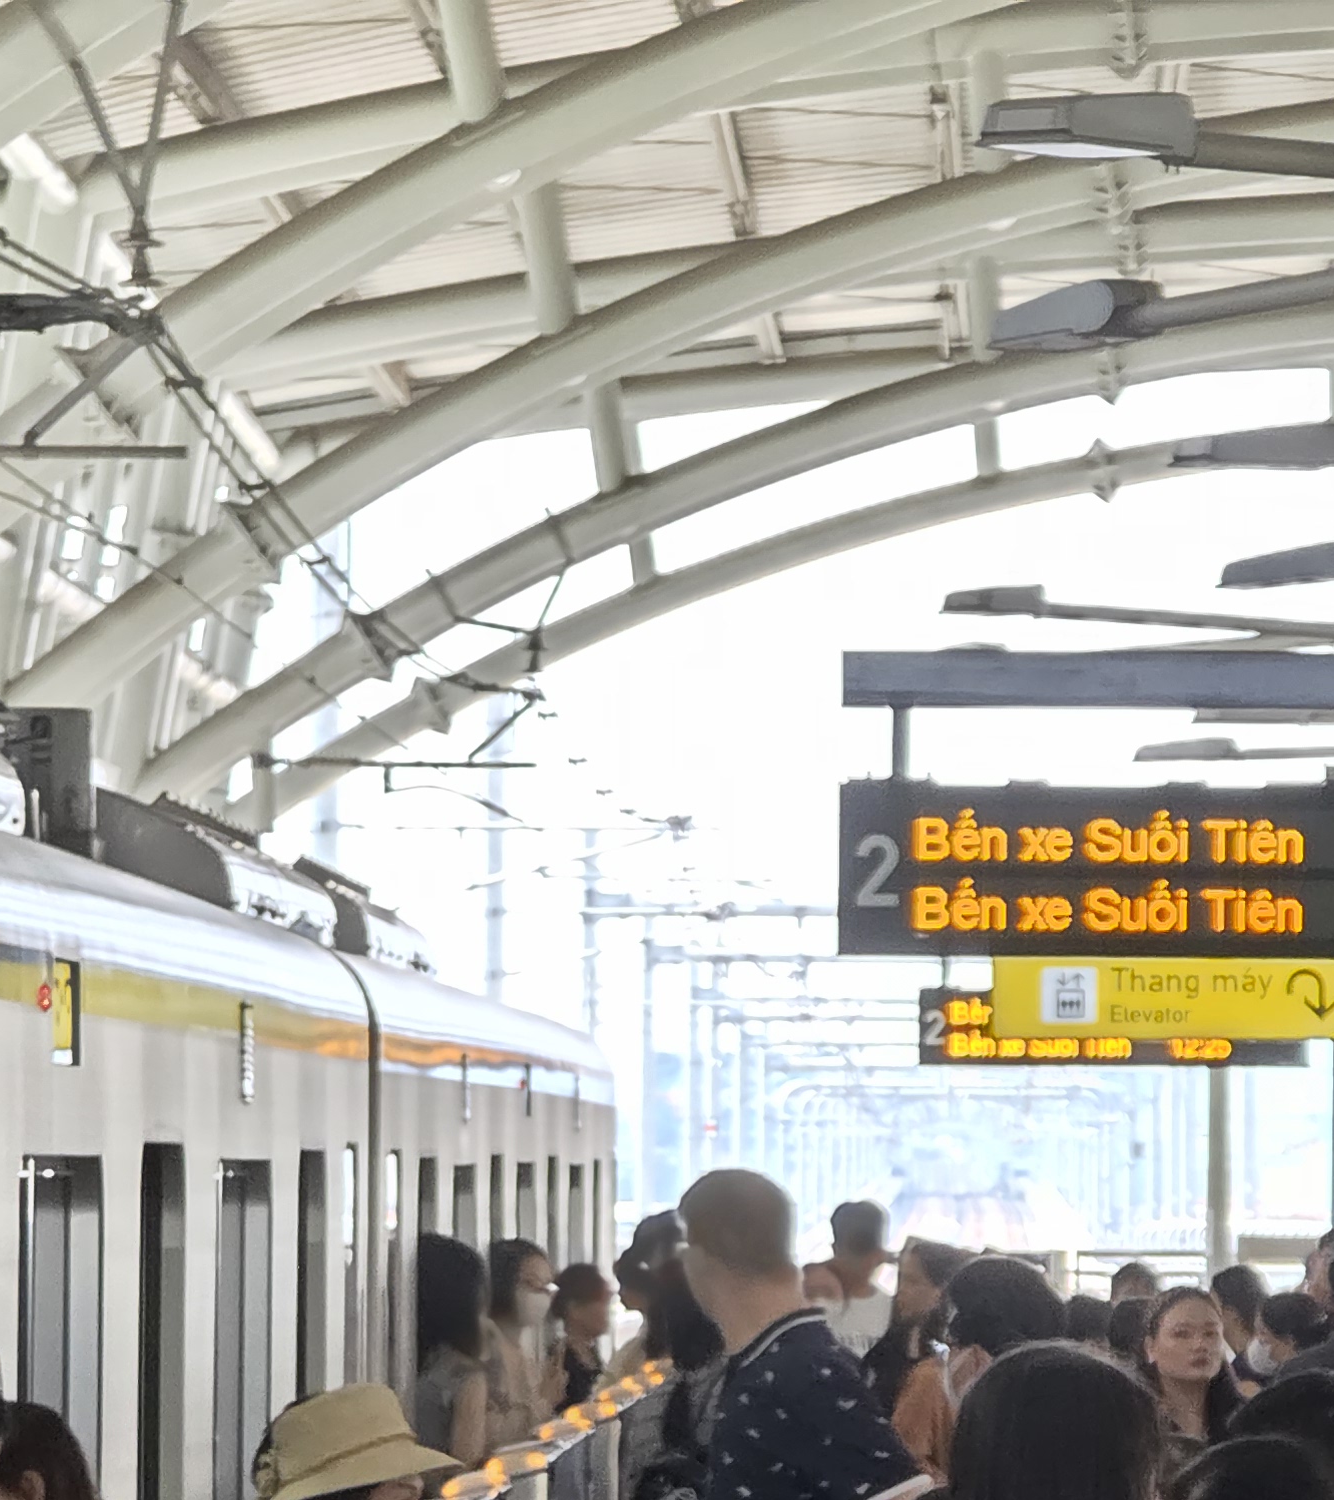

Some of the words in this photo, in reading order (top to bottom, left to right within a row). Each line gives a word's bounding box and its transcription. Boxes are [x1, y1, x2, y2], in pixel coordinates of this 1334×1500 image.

[912, 808, 1008, 863] Bến
[1017, 827, 1074, 862] xe
[1082, 809, 1188, 863] Suối
[1202, 818, 1305, 864] Tiên
[855, 833, 900, 908] 2
[912, 877, 1008, 932] Bến
[1017, 897, 1074, 932] xe
[1082, 879, 1188, 933] Suối
[1202, 888, 1305, 933] Tiên
[1110, 967, 1200, 999] Thang
[1213, 967, 1273, 1000] máy
[922, 1009, 946, 1045] 2
[1110, 1004, 1191, 1023] Elevator
